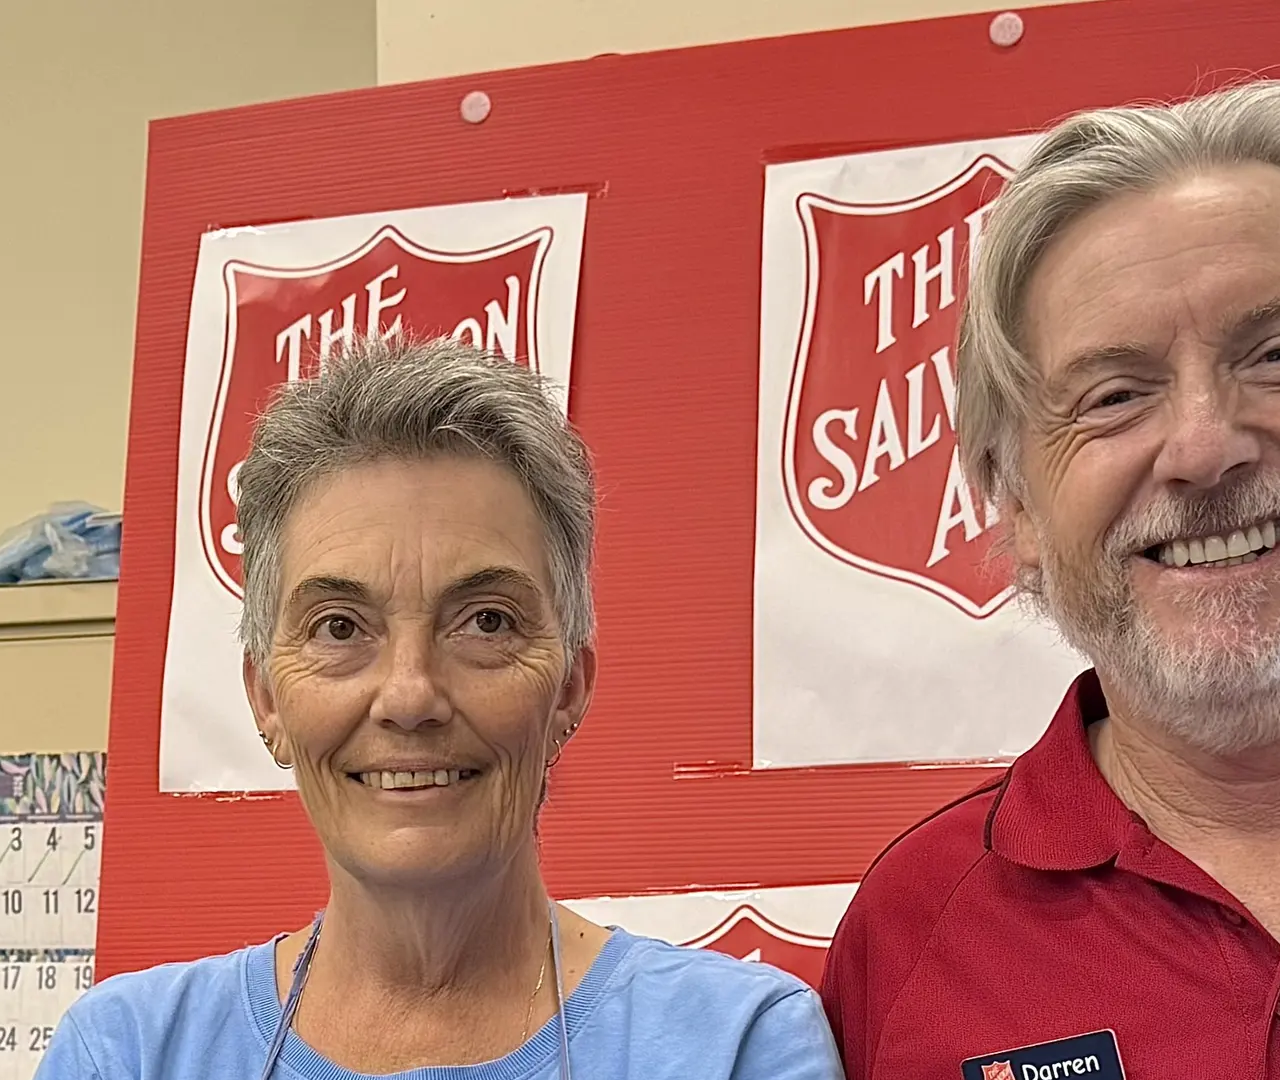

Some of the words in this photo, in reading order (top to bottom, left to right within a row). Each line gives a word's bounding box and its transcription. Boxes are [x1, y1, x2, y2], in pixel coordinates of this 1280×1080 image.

[11, 827, 22, 851] 3
[46, 826, 58, 851] 4
[84, 826, 95, 850] 5
[2, 890, 22, 914] 10
[43, 889, 58, 914] 11
[75, 889, 95, 913] 12
[2, 966, 21, 989] 17
[37, 966, 56, 989] 18
[74, 966, 92, 989] 19
[29, 1027, 53, 1051] 25
